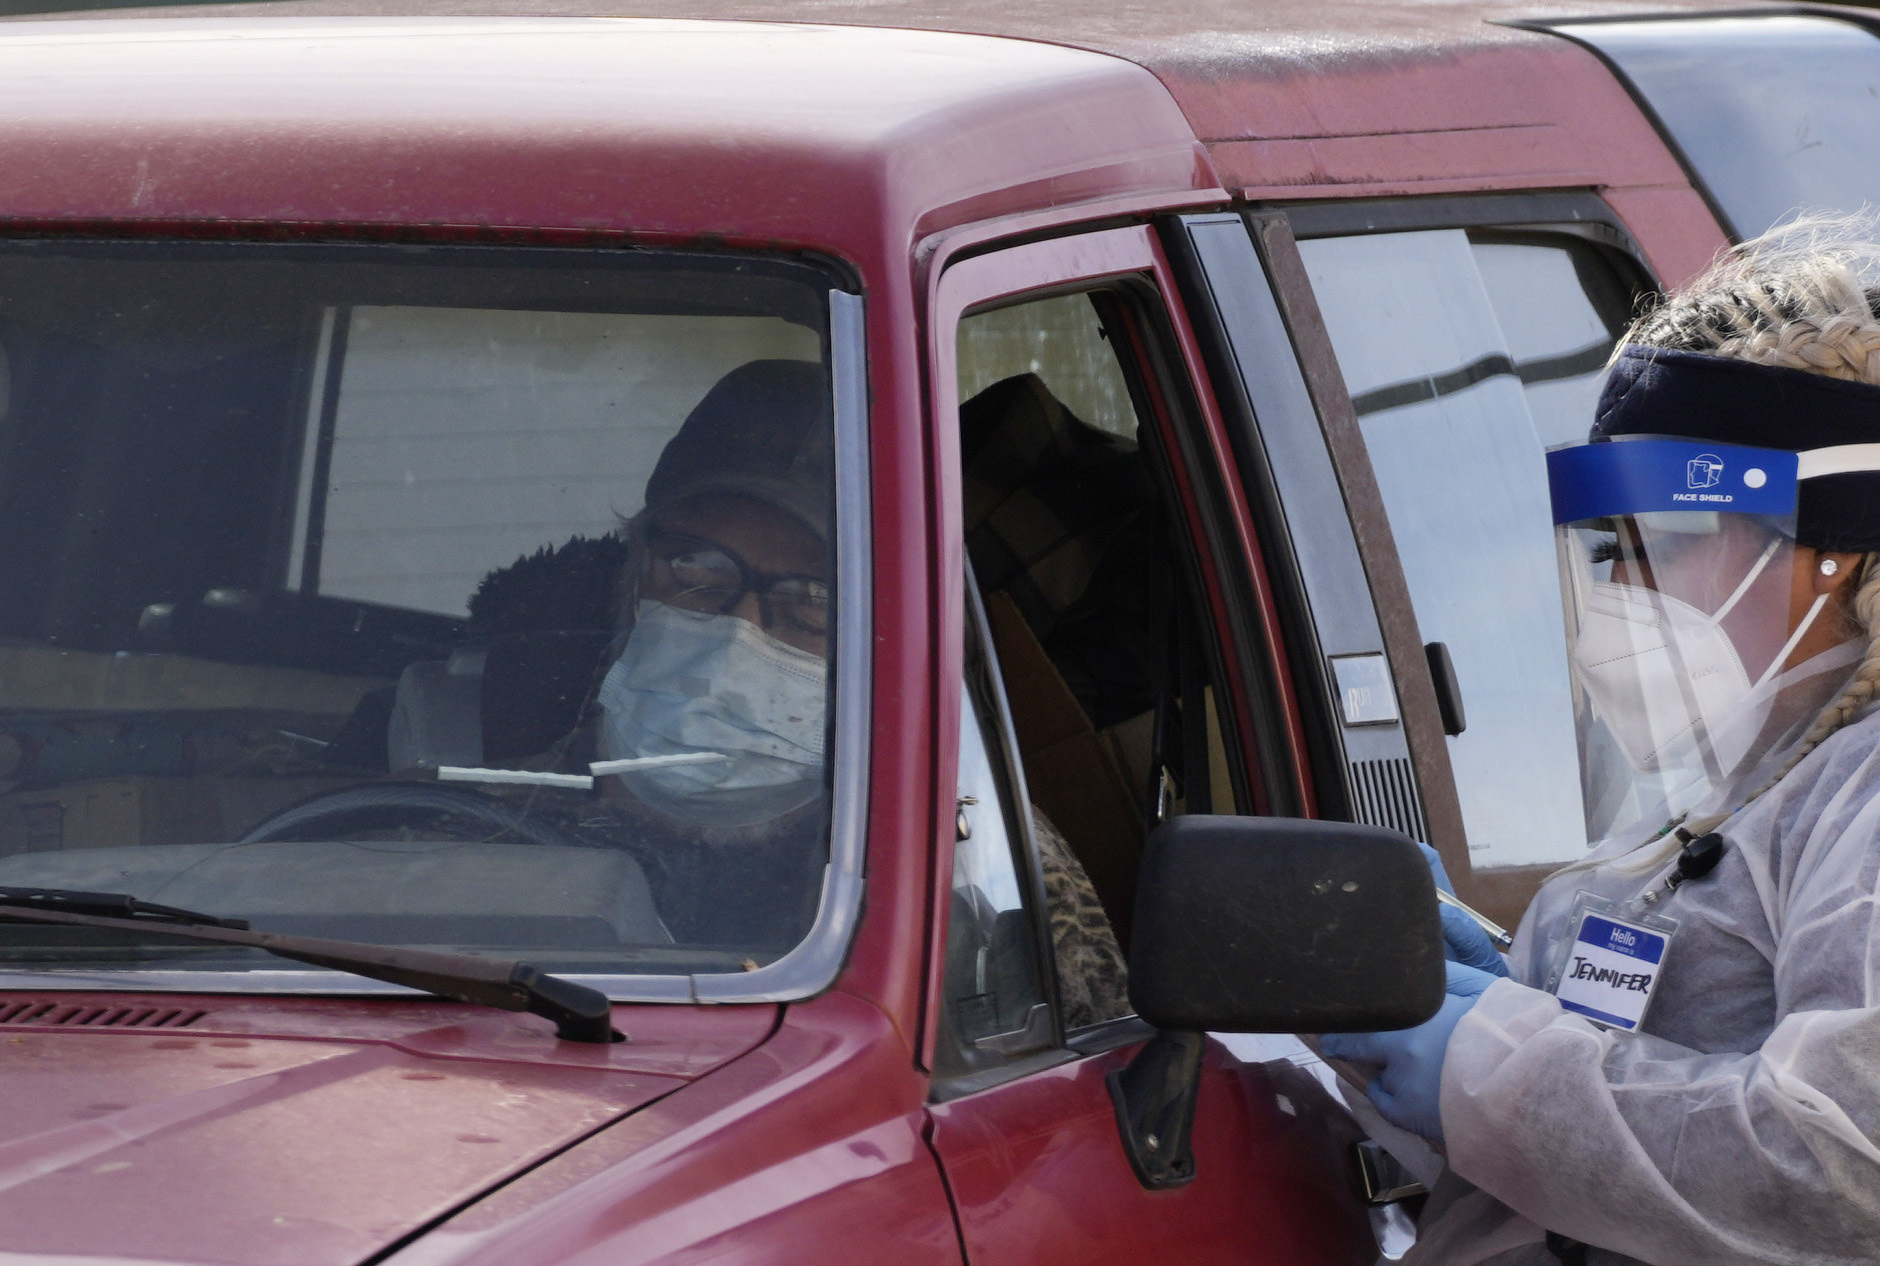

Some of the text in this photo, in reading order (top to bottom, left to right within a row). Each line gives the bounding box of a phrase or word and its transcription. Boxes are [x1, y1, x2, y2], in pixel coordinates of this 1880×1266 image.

[1672, 493, 1734, 503] FACE SHIELD
[1609, 926, 1636, 947] Hello
[1569, 956, 1652, 995] JENNIFER
